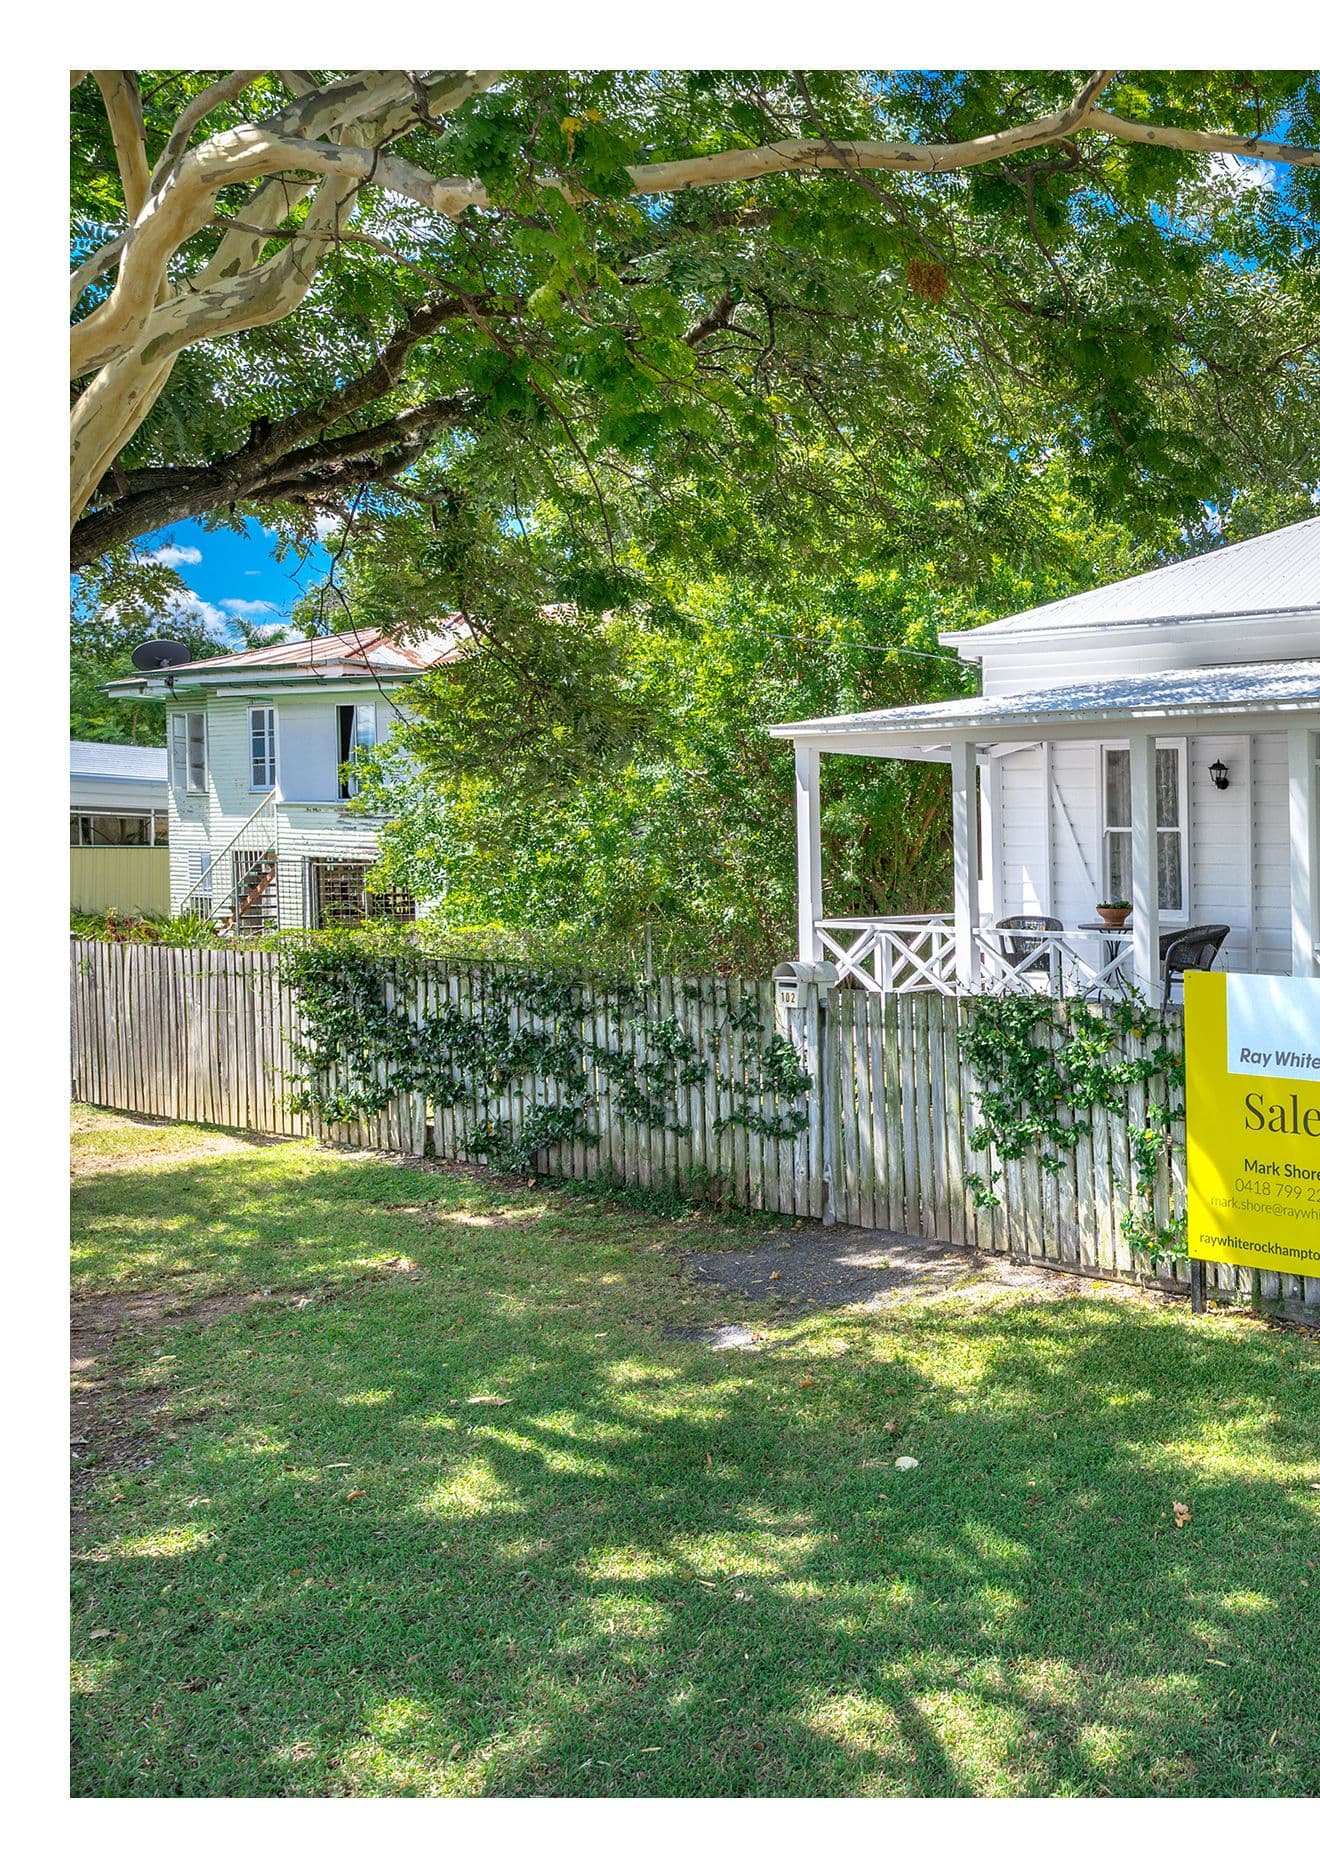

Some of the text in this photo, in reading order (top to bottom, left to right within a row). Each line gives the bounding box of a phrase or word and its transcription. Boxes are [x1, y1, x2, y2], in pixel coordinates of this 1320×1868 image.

[780, 991, 796, 1003] 102
[1239, 1048, 1272, 1067] Ray
[1244, 1158, 1280, 1176] Mark
[1235, 1178, 1271, 1196] 0418
[1275, 1184, 1302, 1200] 799
